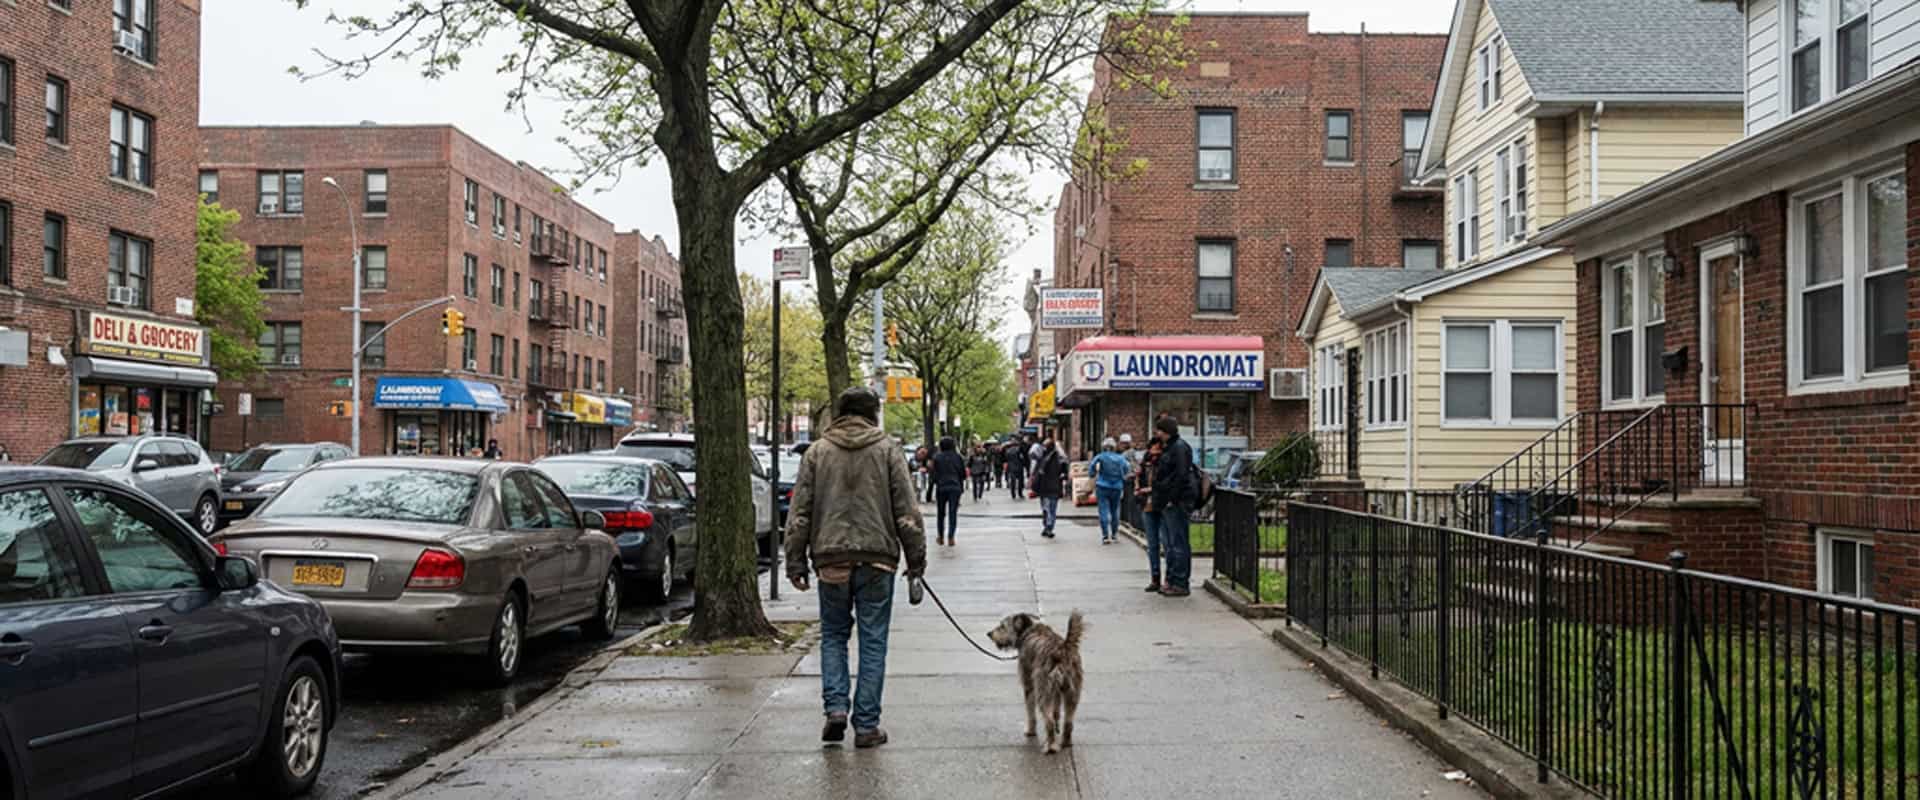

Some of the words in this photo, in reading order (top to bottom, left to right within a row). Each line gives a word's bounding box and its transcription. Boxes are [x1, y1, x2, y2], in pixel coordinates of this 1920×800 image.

[94, 317, 124, 342] DELI
[128, 322, 138, 344] &
[141, 324, 199, 352] GROCERY
[1113, 354, 1259, 377] LAUNDROMAT
